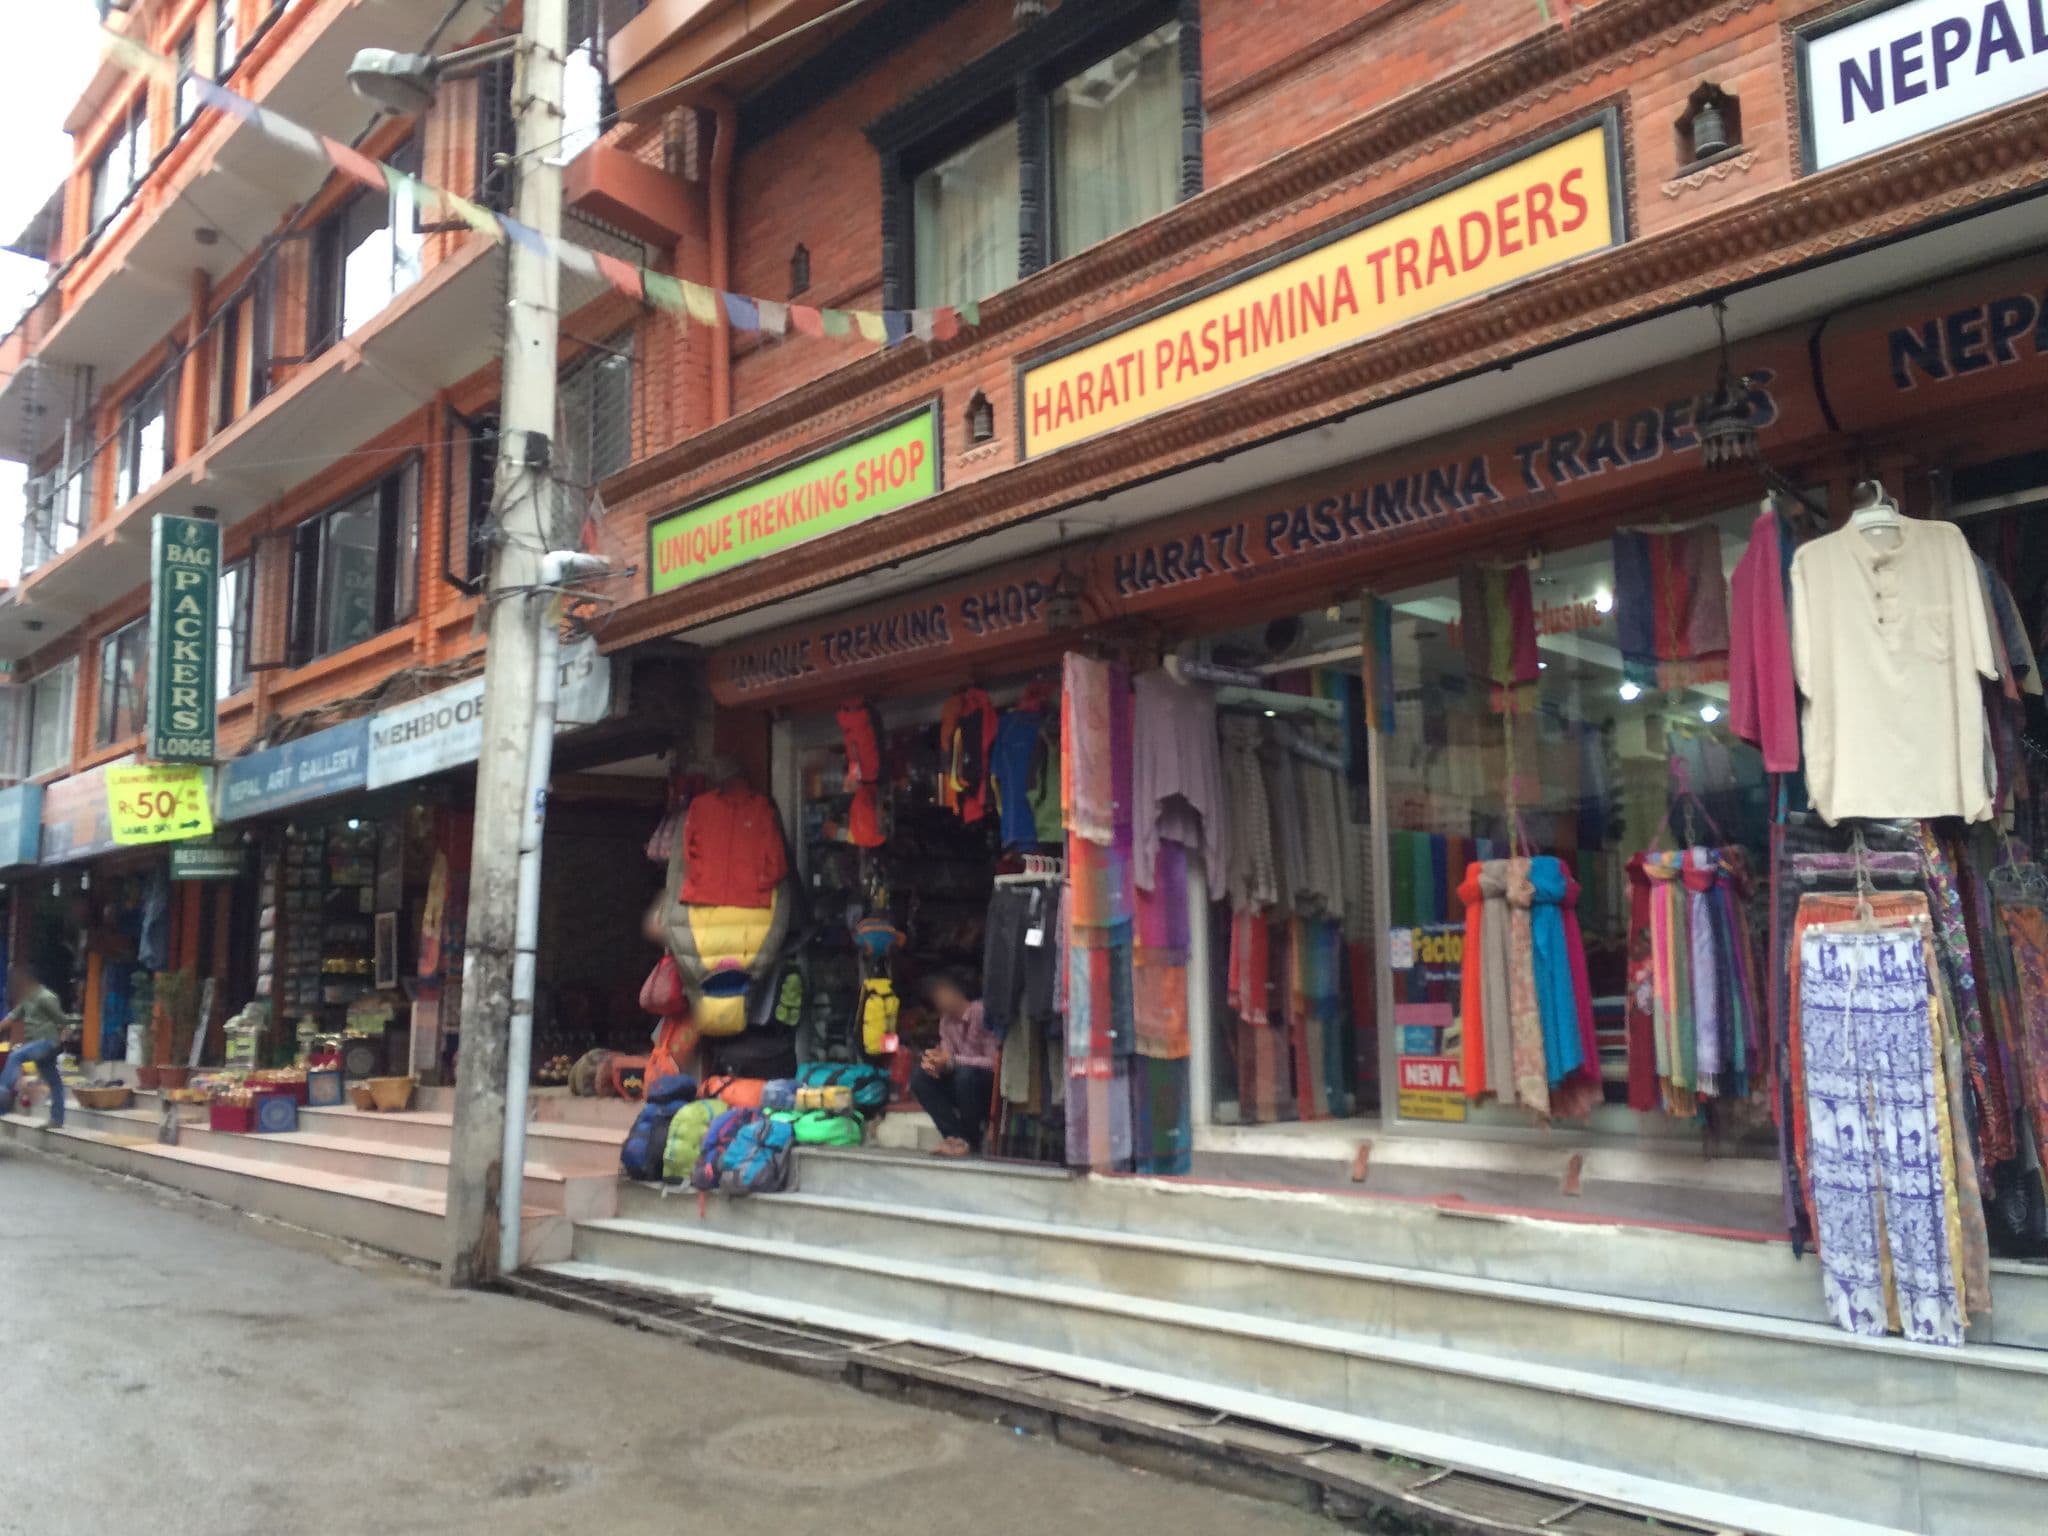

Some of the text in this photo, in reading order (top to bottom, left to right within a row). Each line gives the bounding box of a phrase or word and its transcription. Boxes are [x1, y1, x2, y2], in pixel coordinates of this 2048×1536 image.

[1031, 167, 1589, 438] HARATI PASHMINA TRADERS
[1888, 284, 2048, 391] NEP
[658, 439, 925, 575] UNIQUE TREKKING SHOP
[1113, 367, 1778, 599] HARATI PASHMINA TRADES
[167, 544, 212, 565] BAG
[730, 578, 1050, 690] UNIQUE TREKKING SHOP
[158, 737, 213, 757] LODGE
[1414, 926, 1464, 963] Facto
[1405, 1063, 1464, 1088] NEW A
